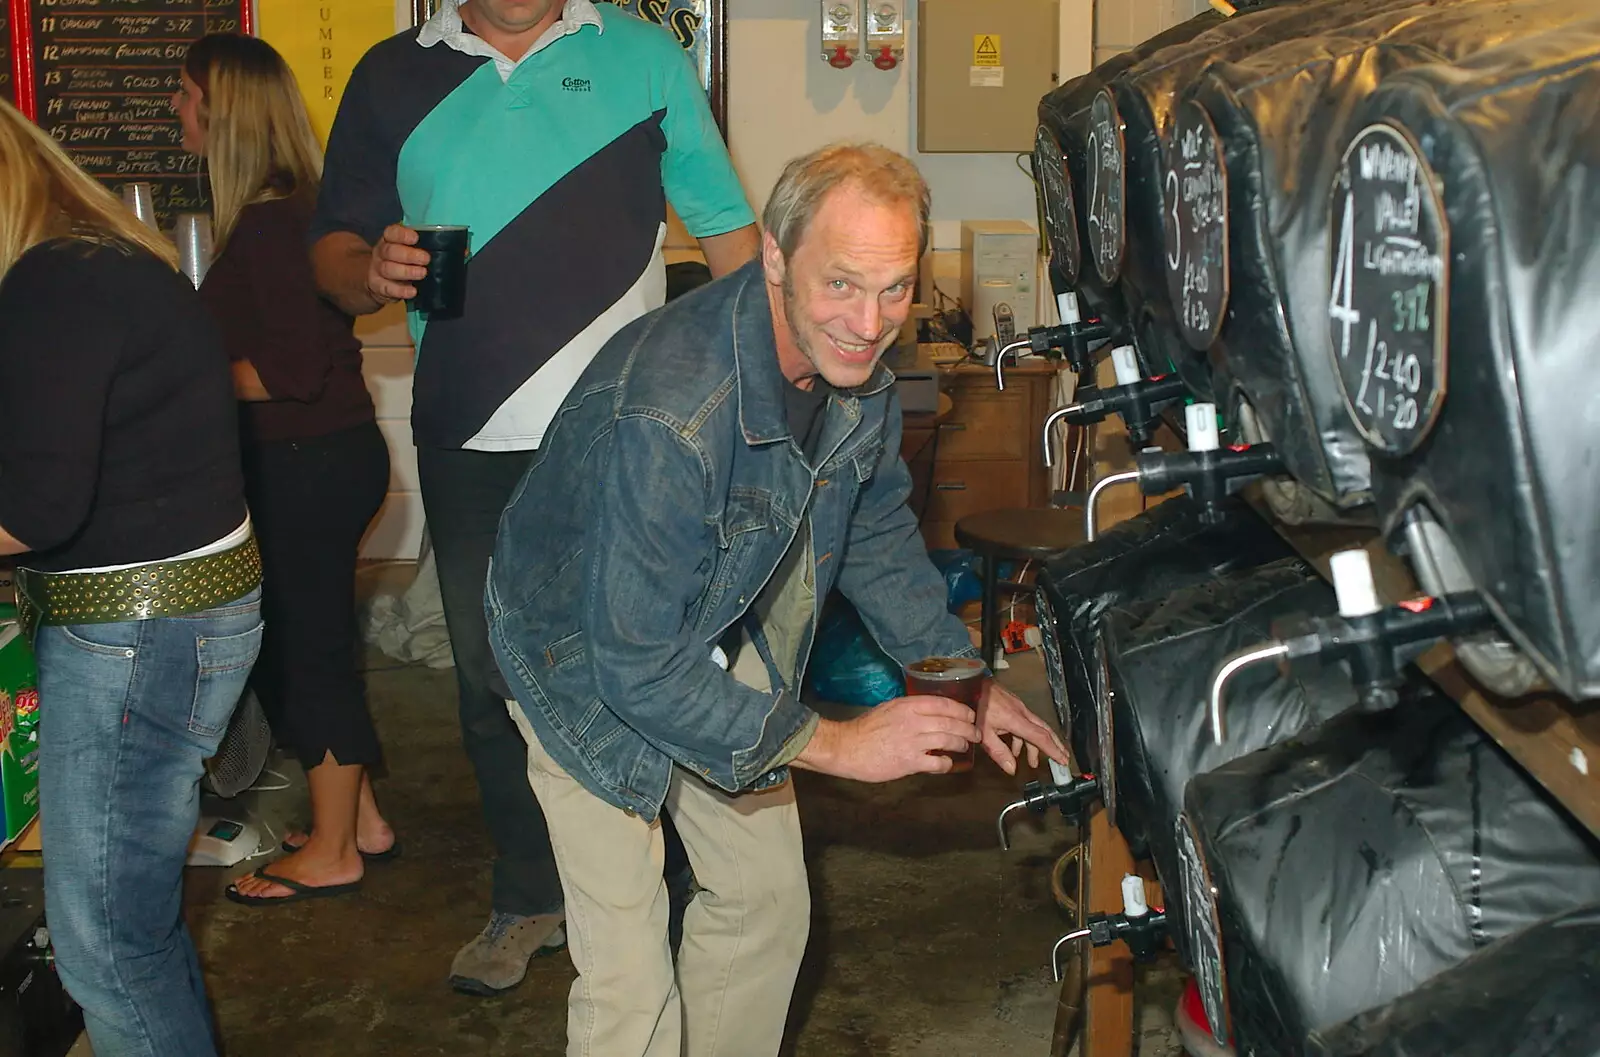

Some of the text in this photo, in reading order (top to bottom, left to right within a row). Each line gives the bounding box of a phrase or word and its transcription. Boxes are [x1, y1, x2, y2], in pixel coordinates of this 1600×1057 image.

[41, 16, 56, 33] 11
[120, 25, 150, 35] MILD
[43, 44, 59, 60] 12
[44, 70, 61, 86] 13
[122, 75, 160, 88] GOLD
[562, 77, 591, 88] Cotton
[47, 98, 63, 116] 14
[136, 108, 160, 118] WIT
[50, 124, 67, 142] 15
[69, 126, 111, 141] BUFFY
[116, 160, 162, 173] BITTER
[1166, 168, 1182, 272] 3
[1329, 191, 1361, 358] 4
